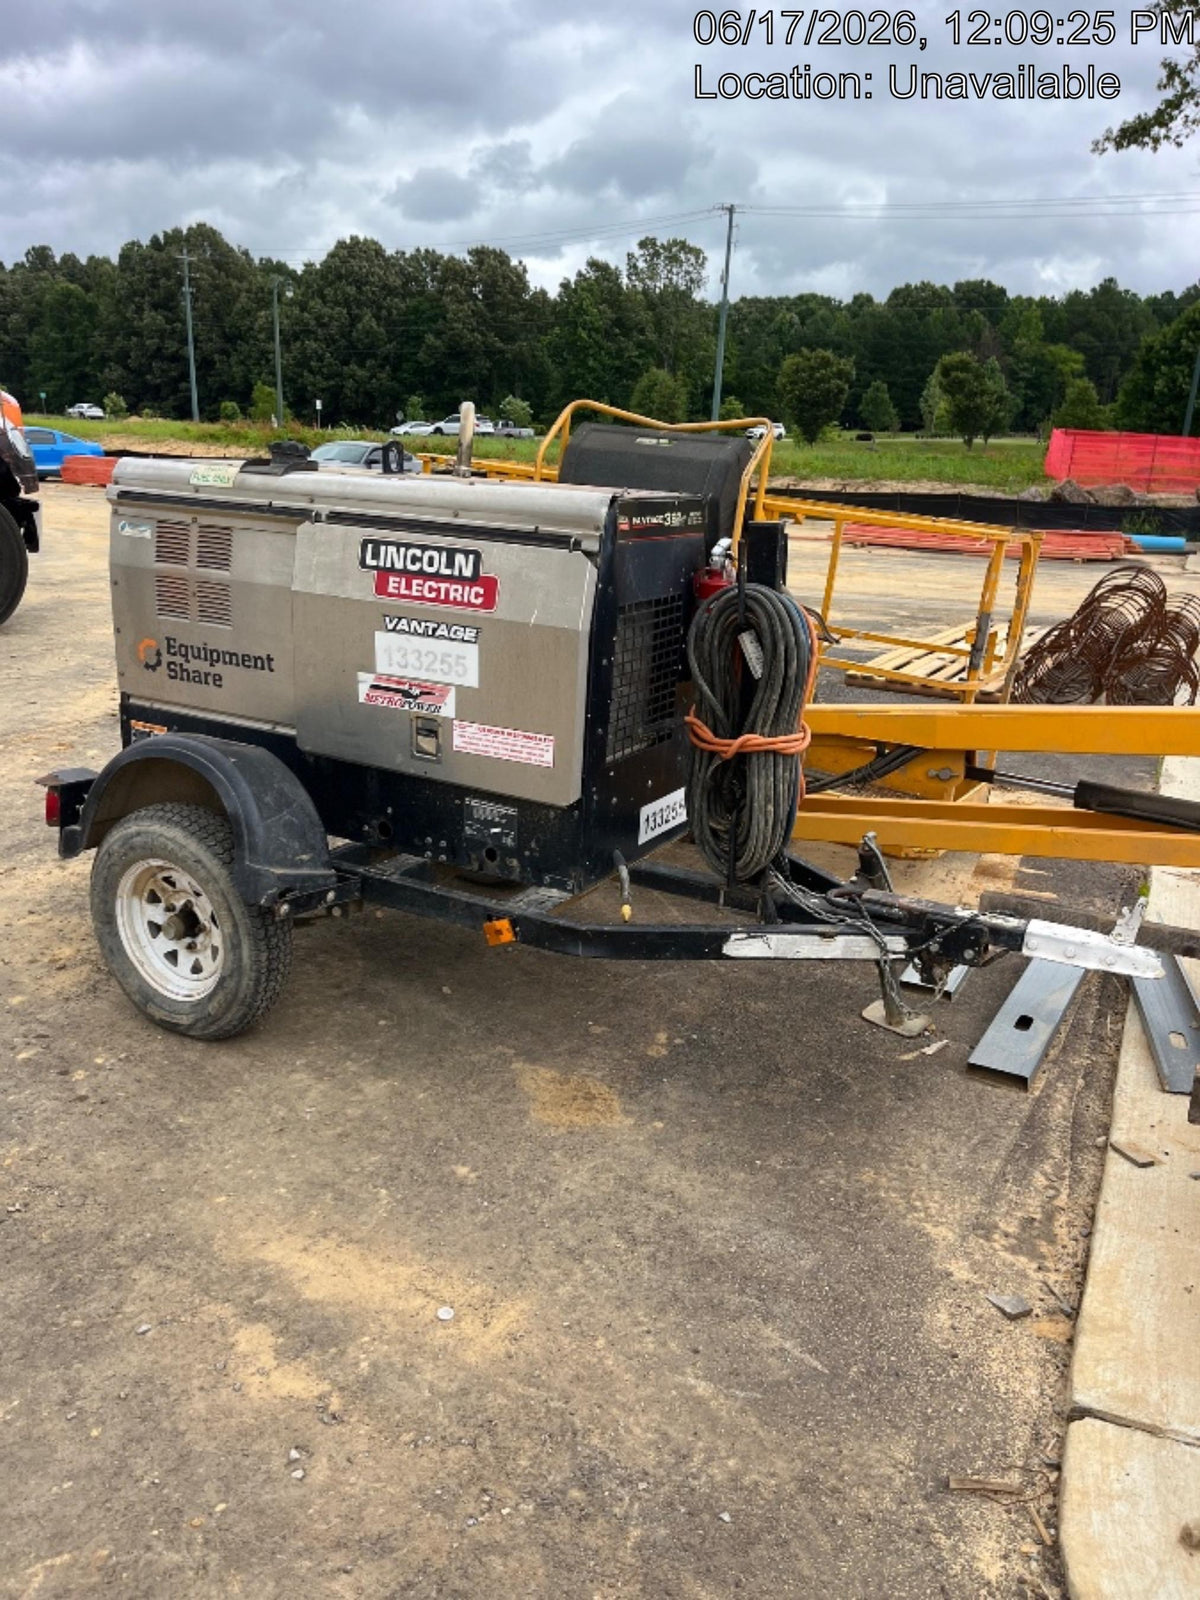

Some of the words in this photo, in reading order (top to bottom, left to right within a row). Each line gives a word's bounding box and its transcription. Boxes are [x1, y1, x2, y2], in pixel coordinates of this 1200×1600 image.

[365, 543, 476, 578] LINCOLN
[387, 576, 485, 606] ELECTRIC
[384, 615, 479, 643] VANTAGE
[165, 637, 275, 673] Equipment
[384, 644, 469, 679] 133255
[166, 661, 224, 688] Share
